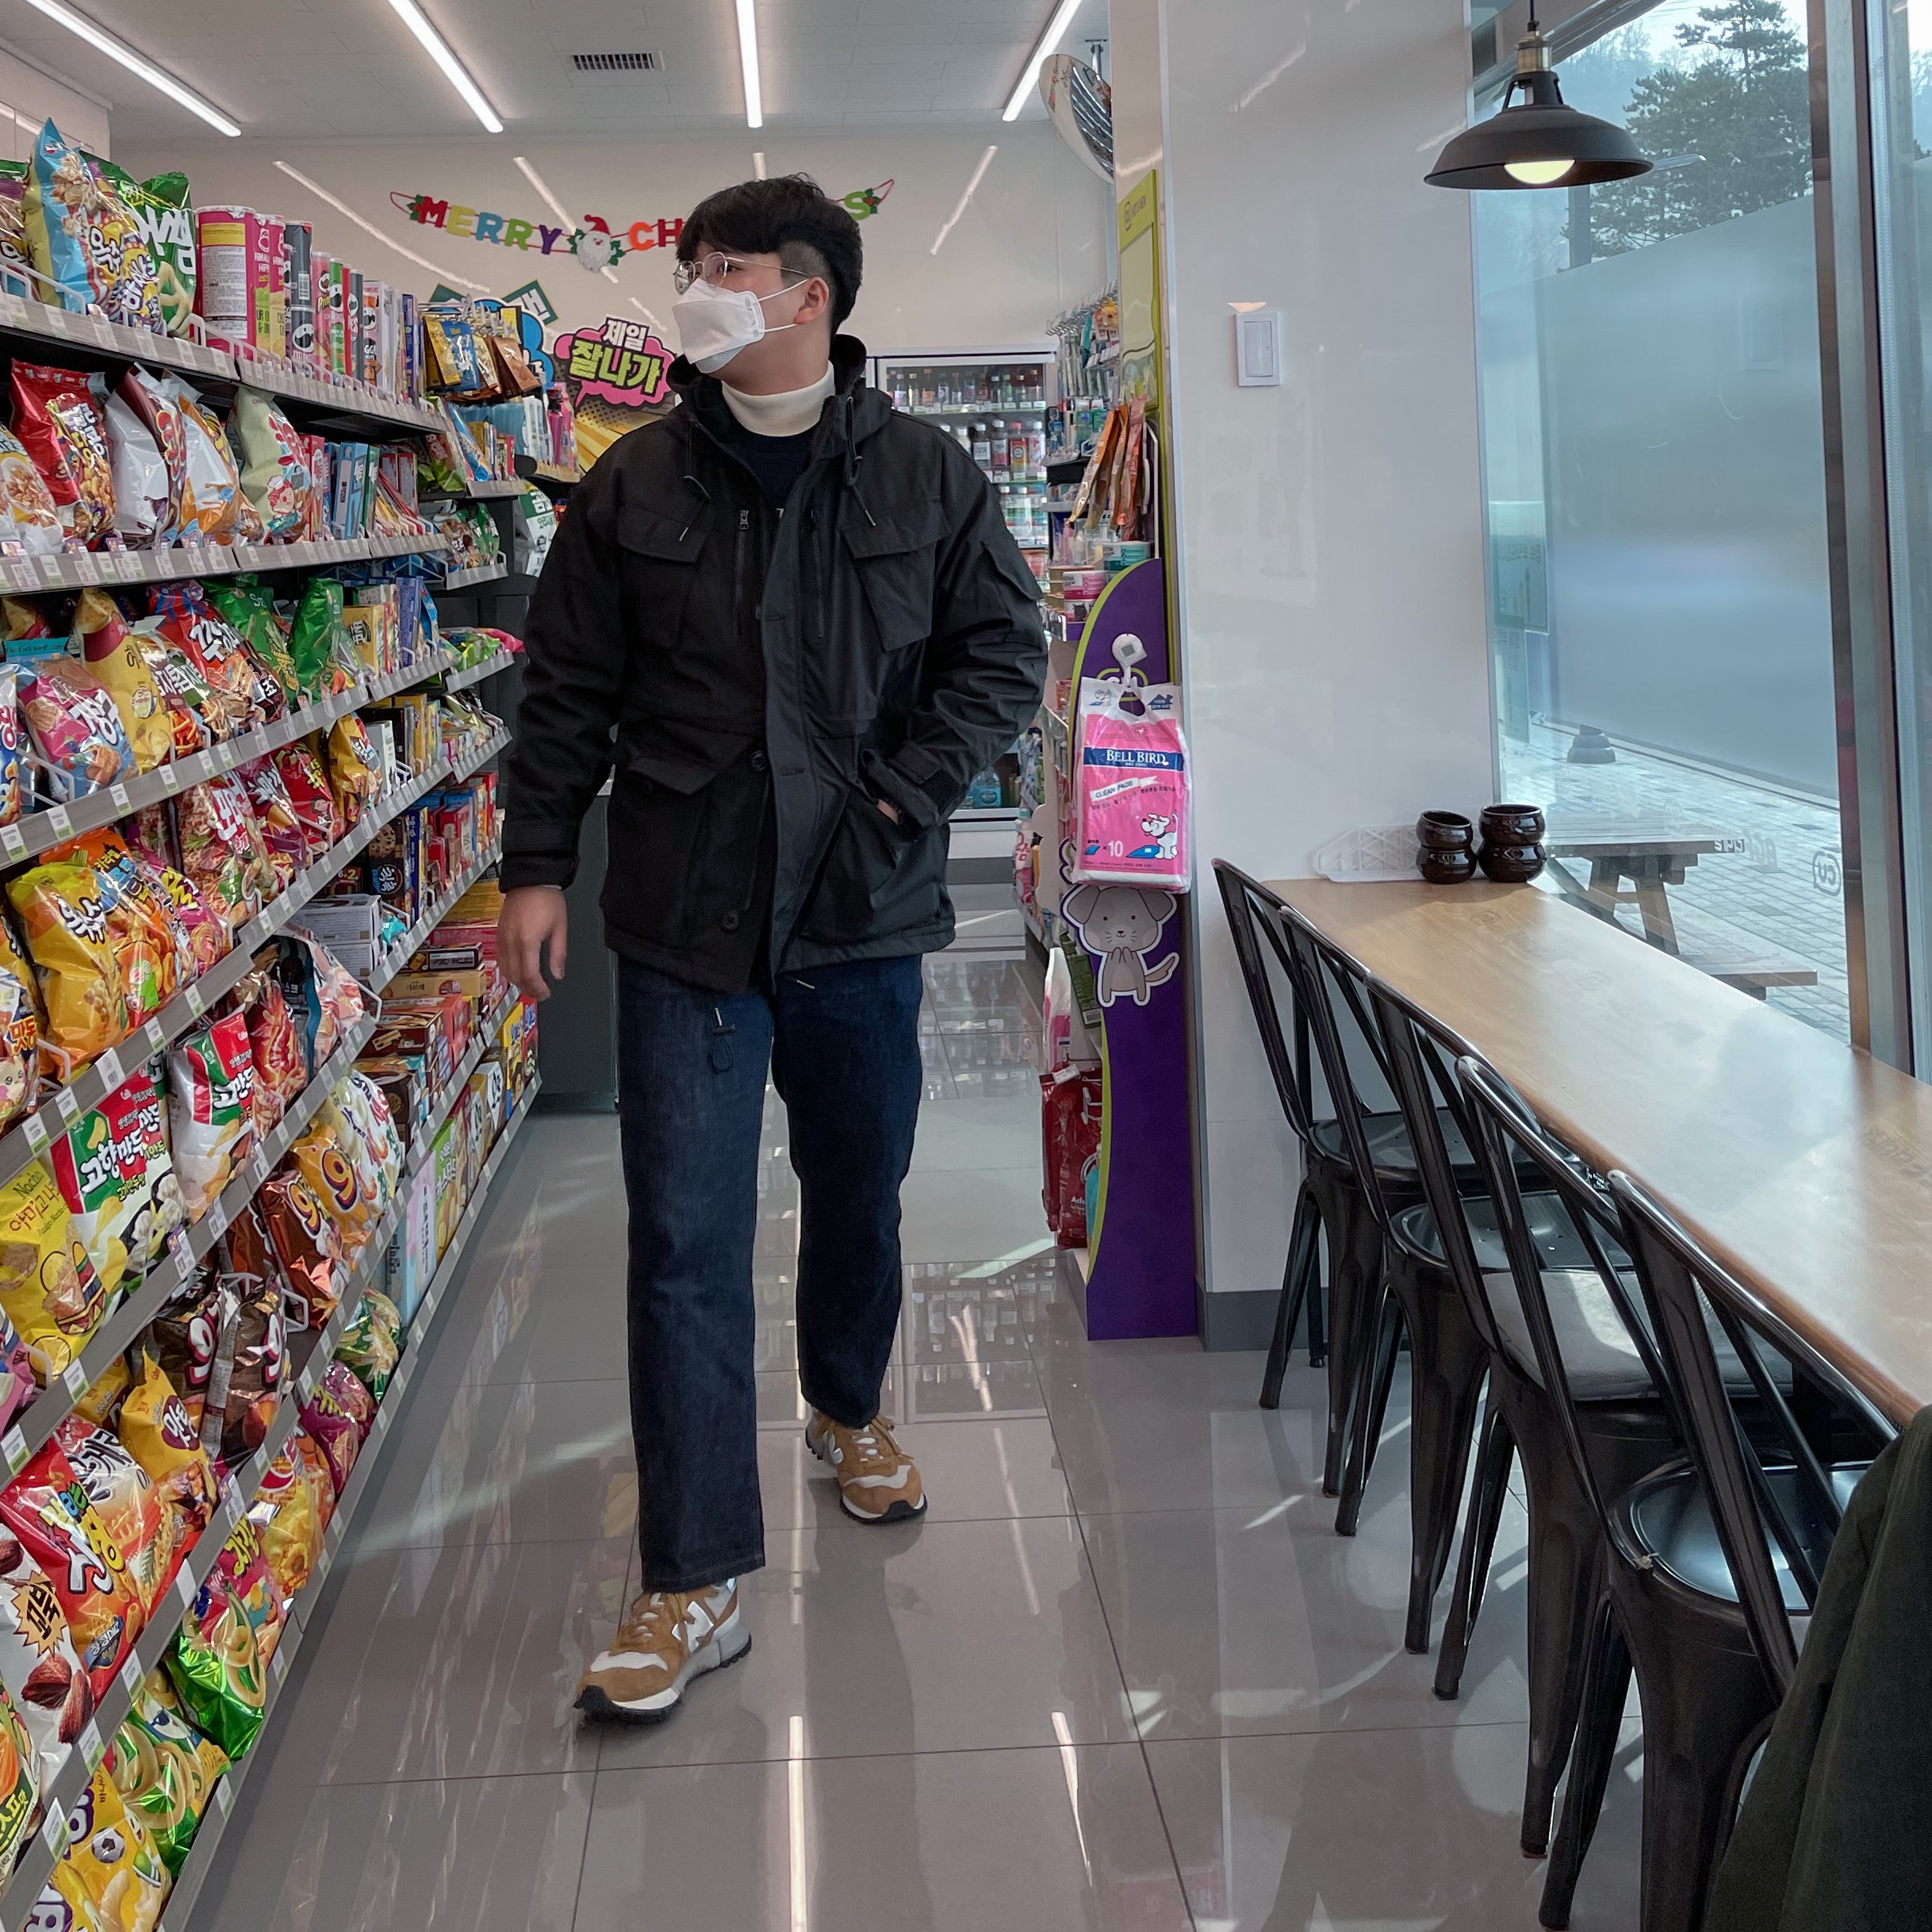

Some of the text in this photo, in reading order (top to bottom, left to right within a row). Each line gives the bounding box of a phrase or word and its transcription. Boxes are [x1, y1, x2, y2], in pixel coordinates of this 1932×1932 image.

[416, 196, 562, 255] MERRY
[604, 319, 648, 352] 제일
[569, 339, 662, 395] 잘나가
[1106, 749, 1167, 765] BELL BIRD
[1095, 787, 1116, 799] CLEAN
[1107, 840, 1124, 857] 10
[80, 1133, 144, 1193] 고향만두
